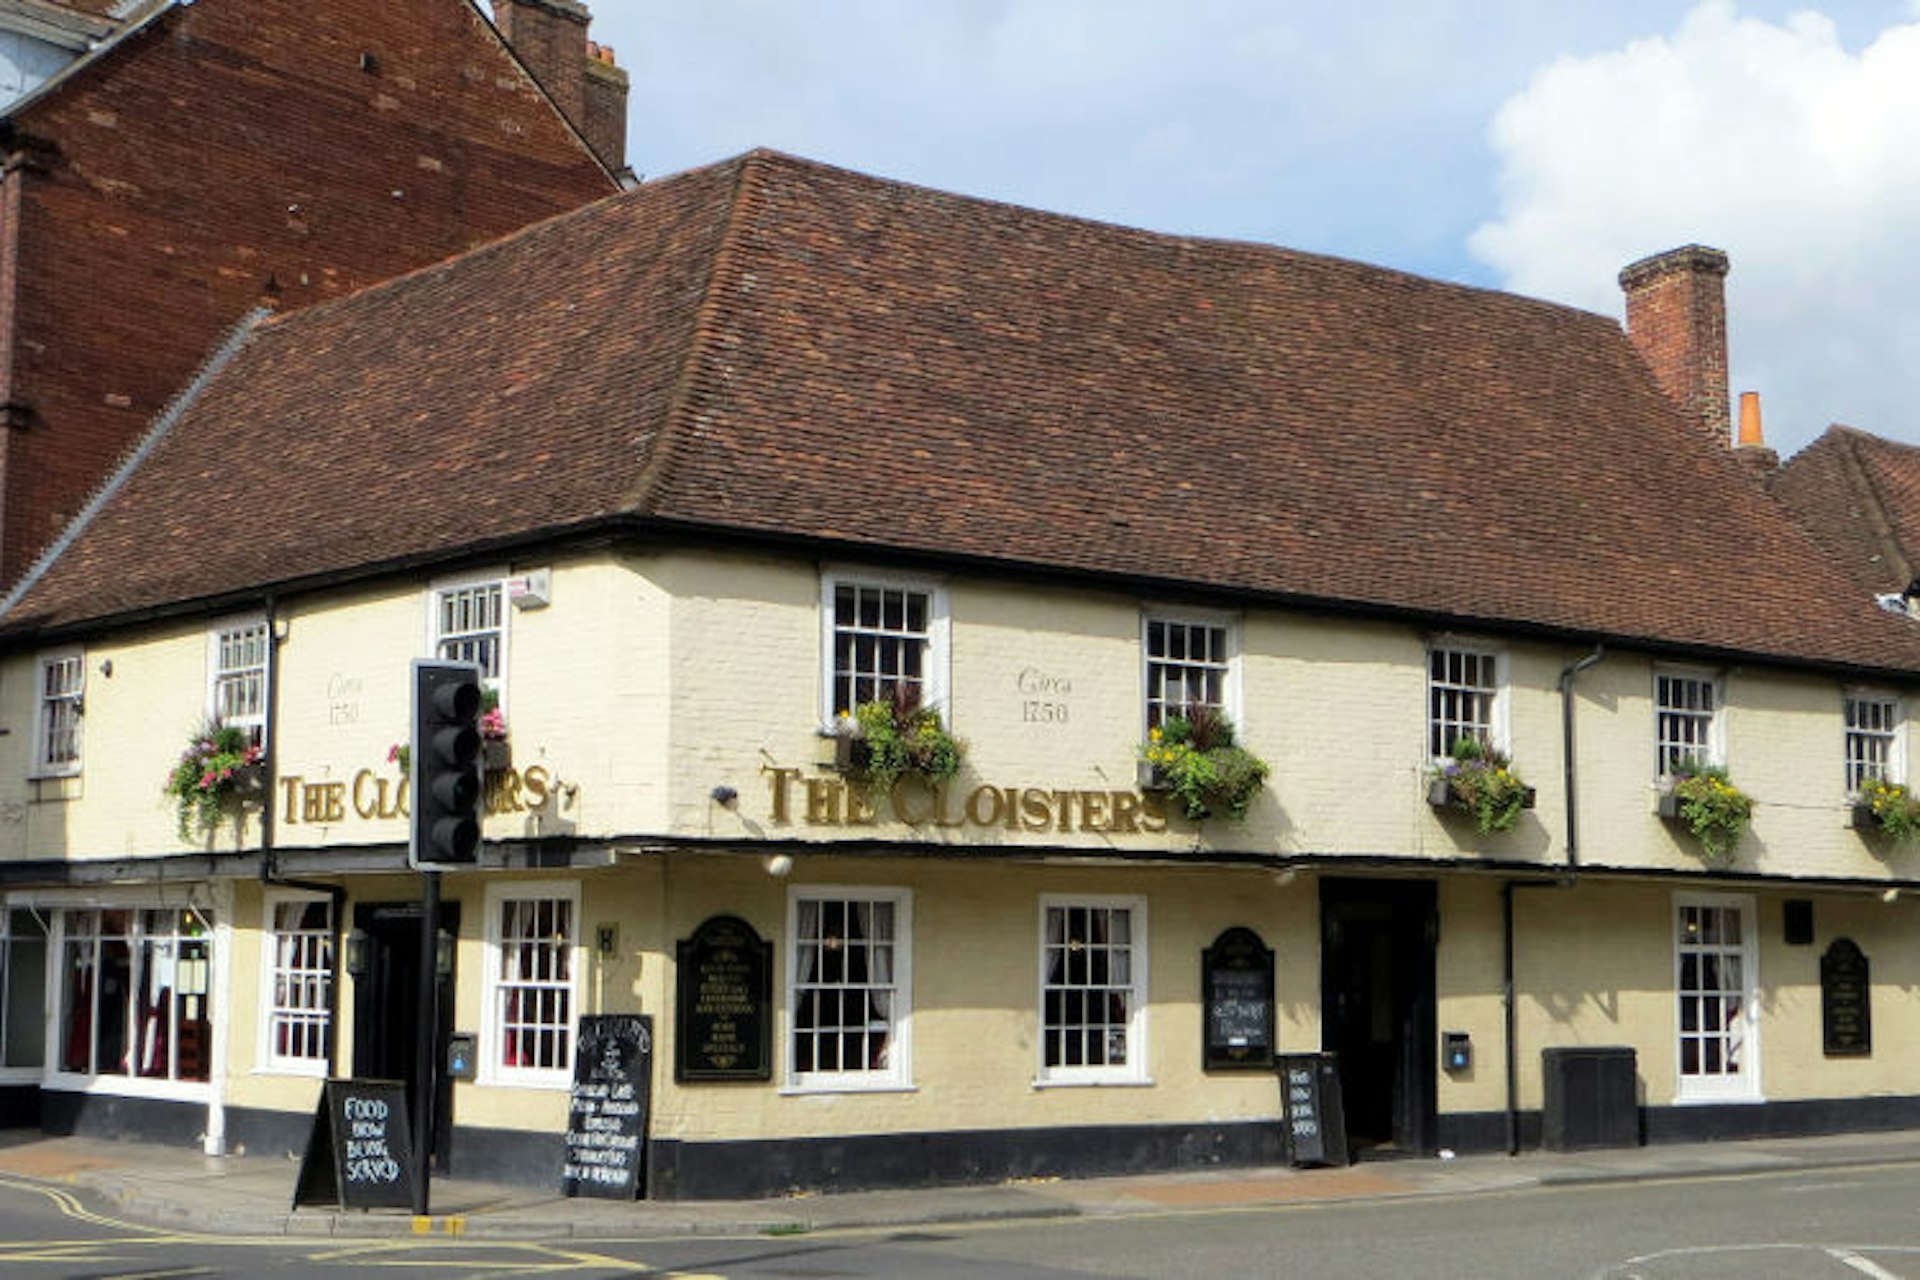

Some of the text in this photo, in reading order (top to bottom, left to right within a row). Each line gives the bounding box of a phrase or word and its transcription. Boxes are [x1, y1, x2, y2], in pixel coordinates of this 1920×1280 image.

[1023, 700, 1068, 724] 1750
[280, 775, 346, 825] THE
[890, 771, 1168, 833] CLOISTERS
[343, 1096, 389, 1121] FOOD
